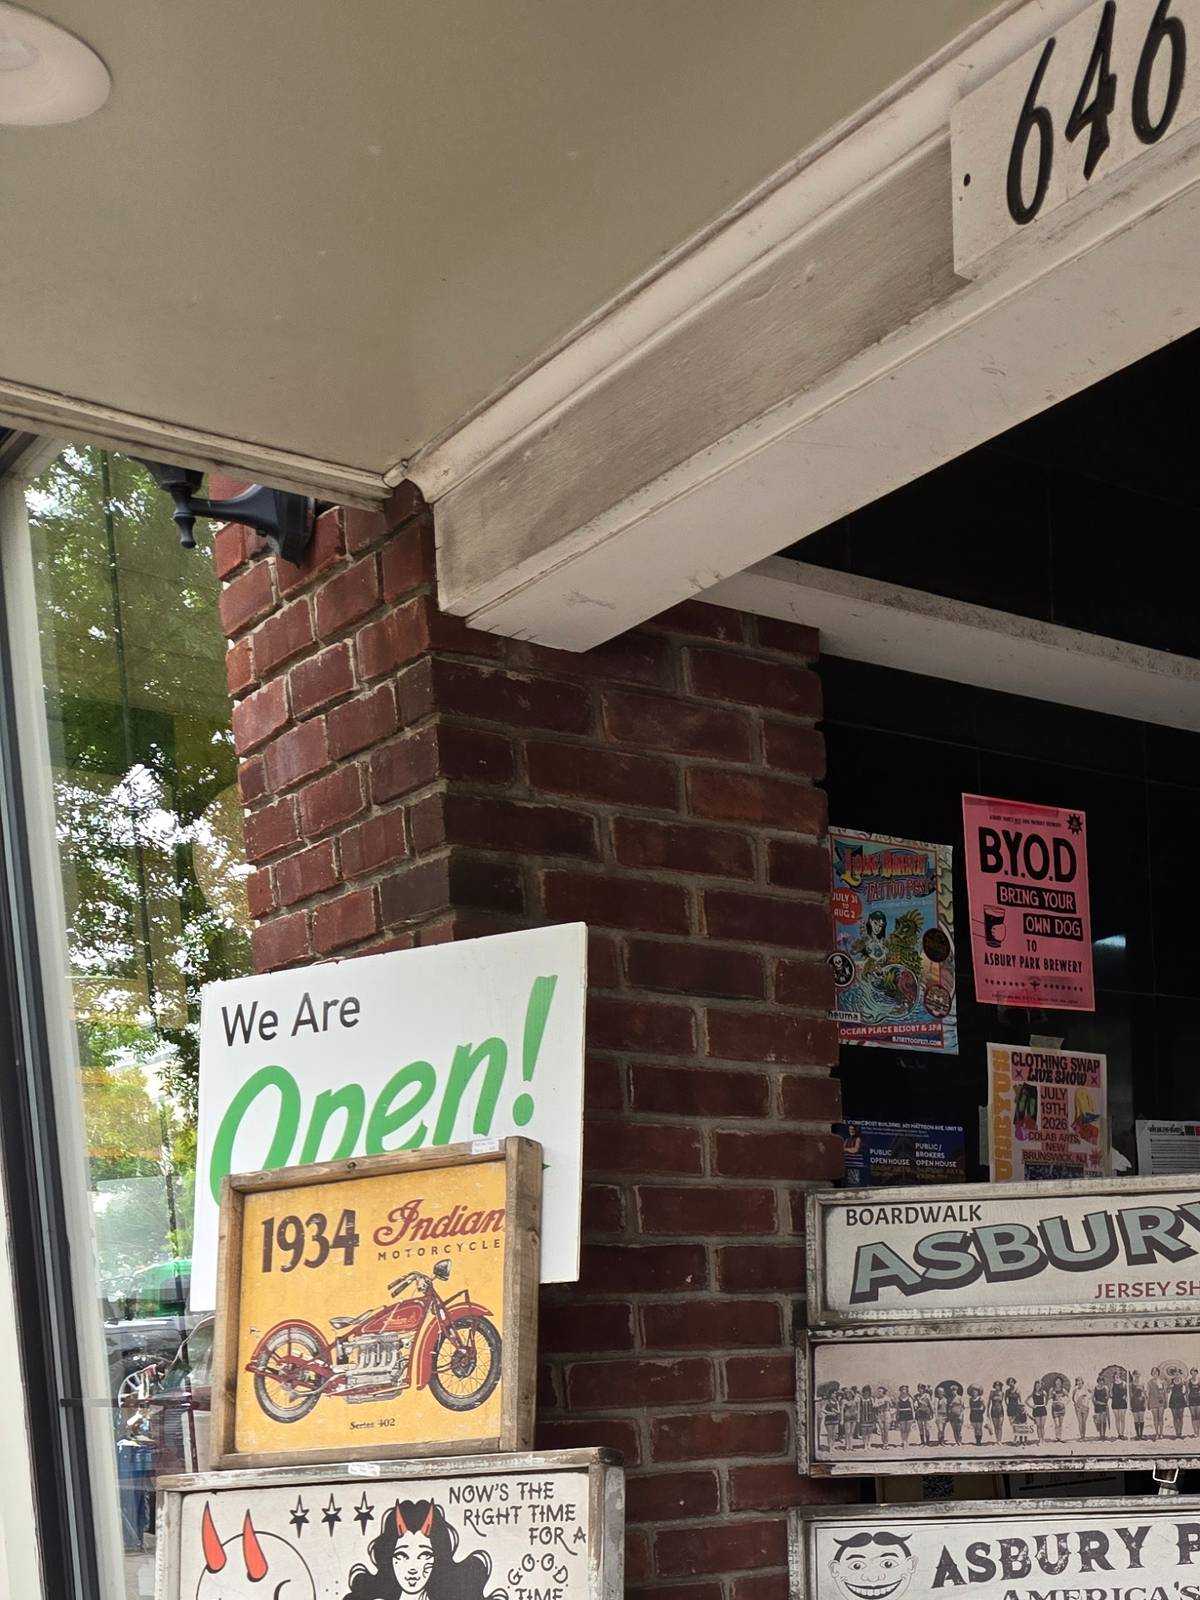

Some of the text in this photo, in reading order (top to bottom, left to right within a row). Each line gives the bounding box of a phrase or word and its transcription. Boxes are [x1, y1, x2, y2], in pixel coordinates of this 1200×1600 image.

[1007, 0, 1186, 225] 646
[832, 892, 848, 902] JULY
[1000, 886, 1074, 910] BRING YOUR
[834, 908, 849, 917] AUG
[1025, 916, 1081, 936] OWN DOG
[1026, 940, 1037, 952] TO
[984, 953, 1082, 973] ASBURY PARK BREWERY
[221, 991, 361, 1047] We Are
[840, 1026, 867, 1036] OCEAN
[868, 1026, 892, 1034] PLACE
[893, 1024, 919, 1033] RESORT
[929, 1023, 941, 1031] SPA
[1011, 1052, 1100, 1073] CLOTHING SWAP
[1055, 1070, 1087, 1086] SHOW
[1041, 1087, 1067, 1100] JULY
[1045, 1143, 1066, 1152] NEW
[373, 1198, 505, 1247] Indian
[845, 1204, 982, 1227] BOARDWALK
[261, 1208, 360, 1273] 1934
[378, 1239, 500, 1261] MOTORCYCLE
[1095, 1281, 1171, 1299] JERSEY
[449, 1481, 555, 1504] NOW'S THE
[464, 1503, 576, 1538] RIGHT TIME
[528, 1526, 587, 1556] FOR A
[930, 1524, 1152, 1589] ASBURY
